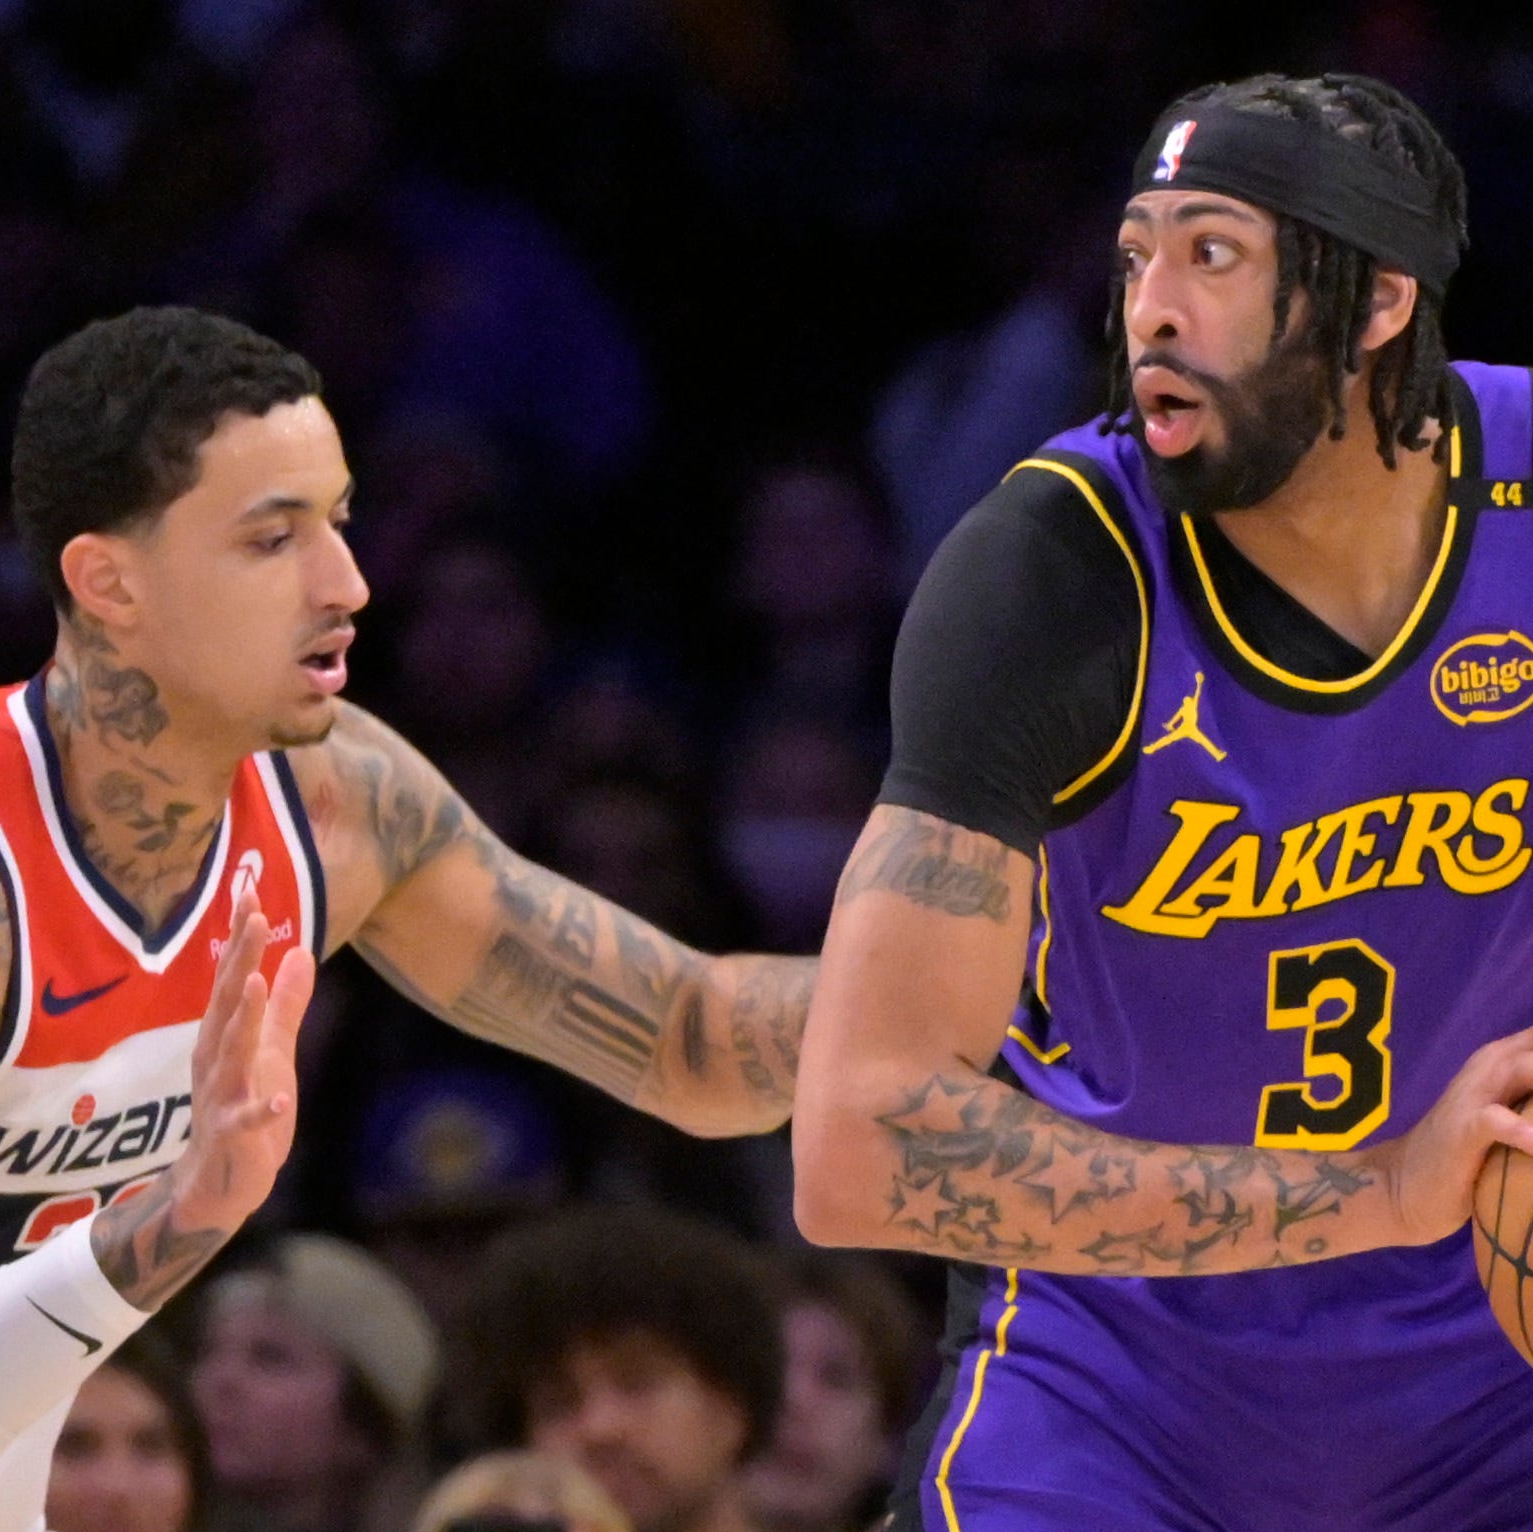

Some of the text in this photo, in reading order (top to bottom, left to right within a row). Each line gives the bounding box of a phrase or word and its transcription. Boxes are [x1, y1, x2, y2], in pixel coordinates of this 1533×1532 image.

[1491, 482, 1522, 507] 44
[1101, 778, 1533, 938] LAKERS
[1255, 938, 1396, 1151] 3
